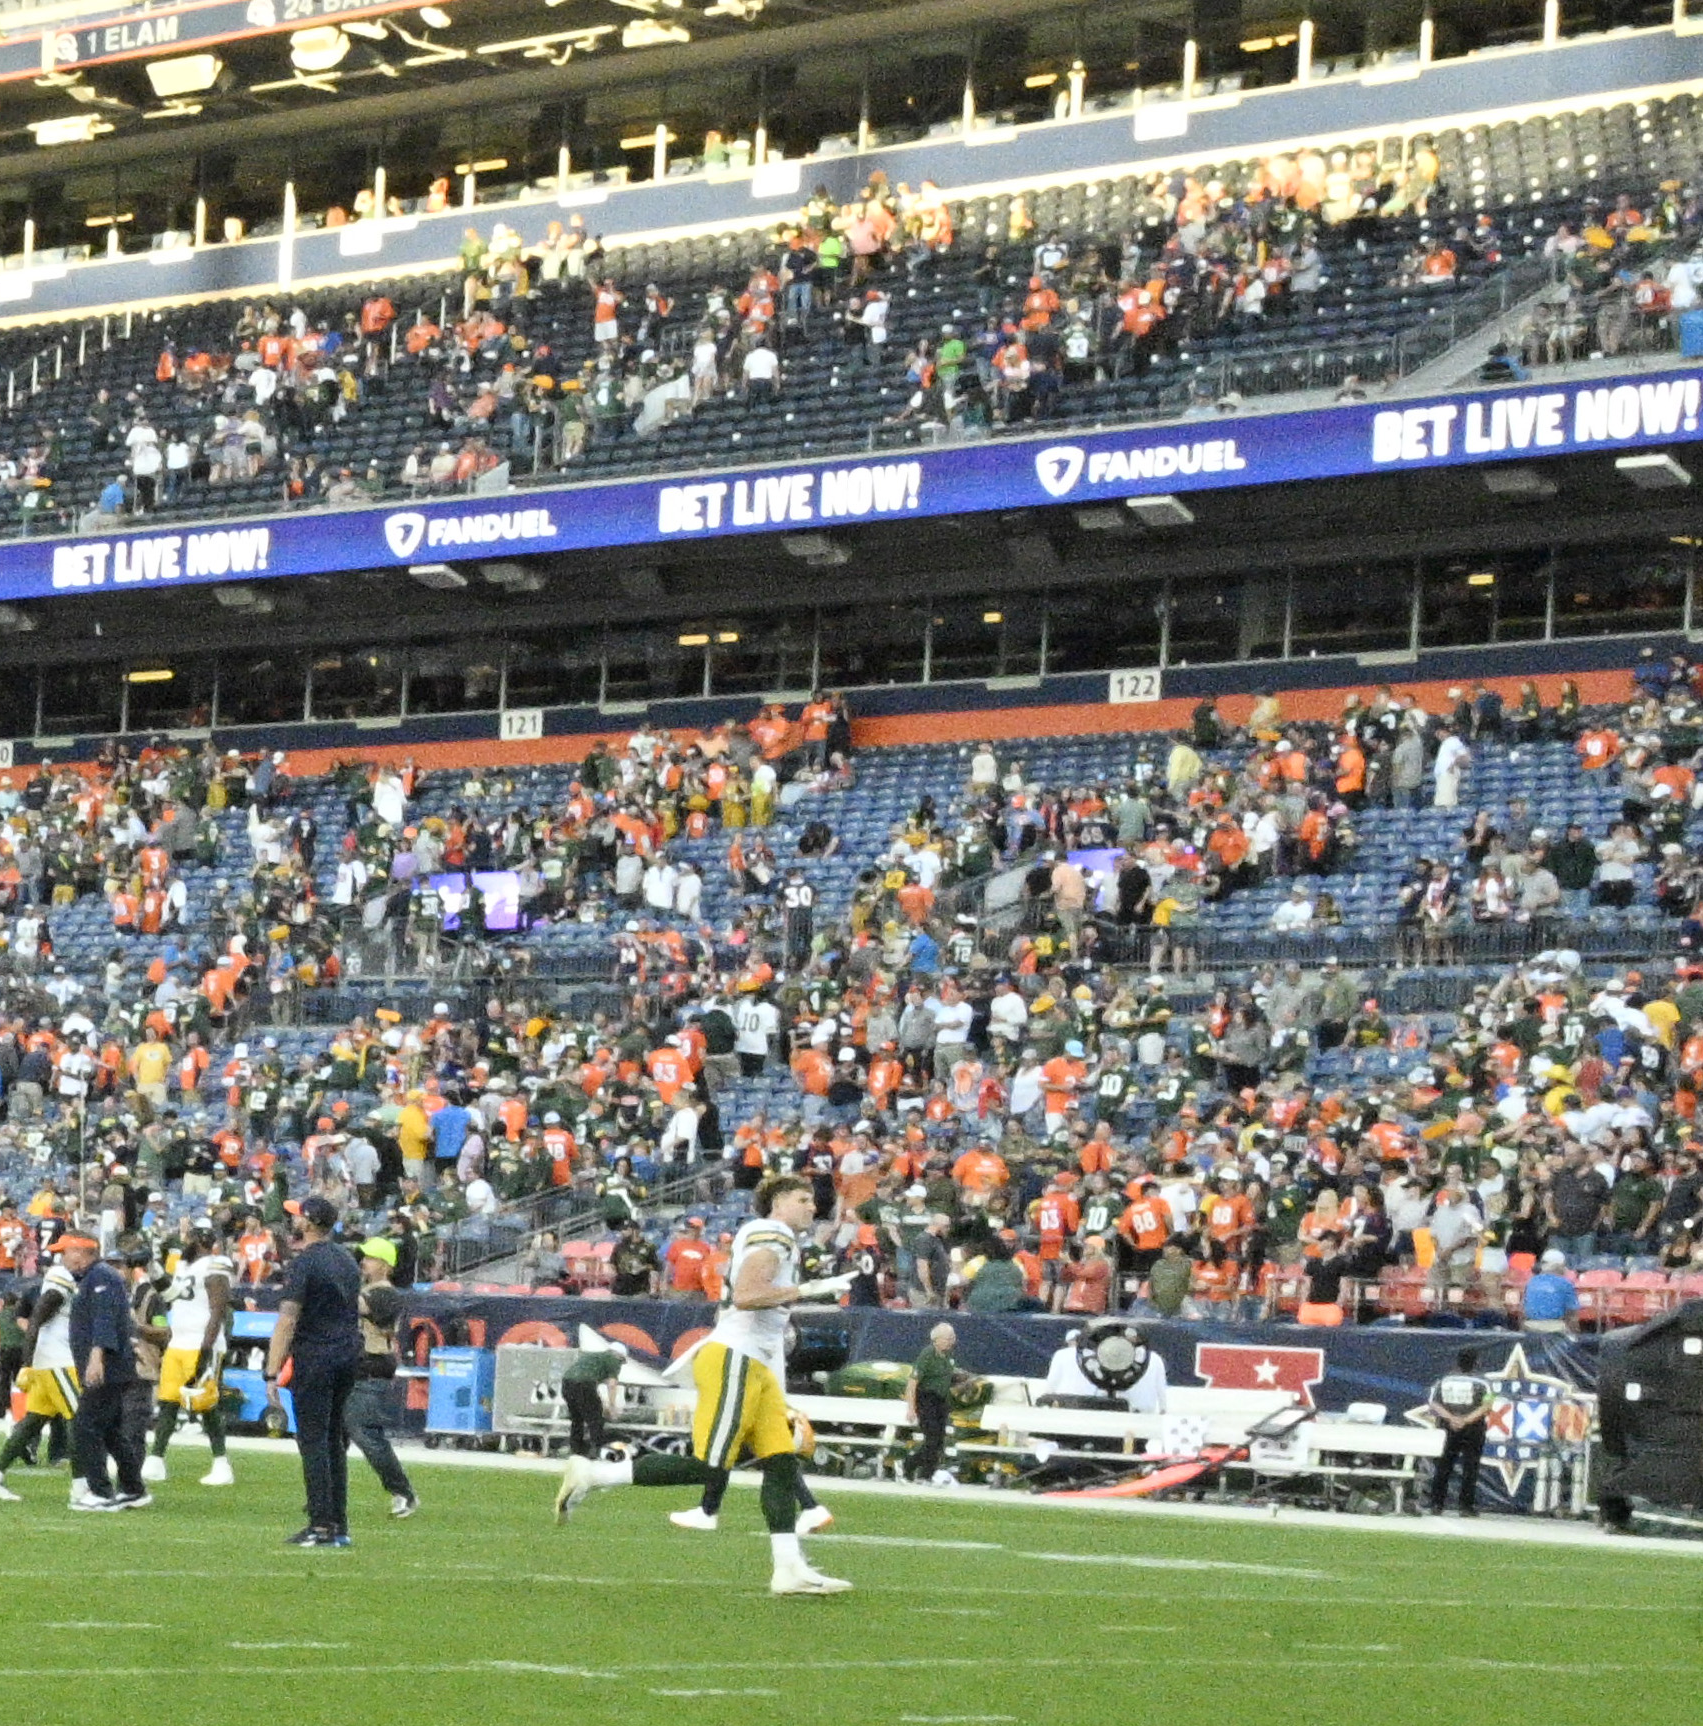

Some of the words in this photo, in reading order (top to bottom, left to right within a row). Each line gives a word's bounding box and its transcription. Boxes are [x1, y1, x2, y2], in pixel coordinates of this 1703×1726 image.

[103, 16, 180, 52] ELAM
[1372, 404, 1458, 462] BET
[1465, 393, 1566, 454] LIVE
[1573, 379, 1702, 444] NOW!
[1088, 440, 1246, 484] FANDUEL
[658, 482, 727, 533] BET
[732, 473, 814, 526] LIVE
[819, 461, 922, 517] NOW!
[427, 509, 557, 547] FANDUEL
[52, 541, 110, 588] BET
[114, 535, 181, 583] LIVE
[185, 527, 271, 577] NOW!
[1116, 674, 1155, 697] 122
[506, 714, 538, 735] 121
